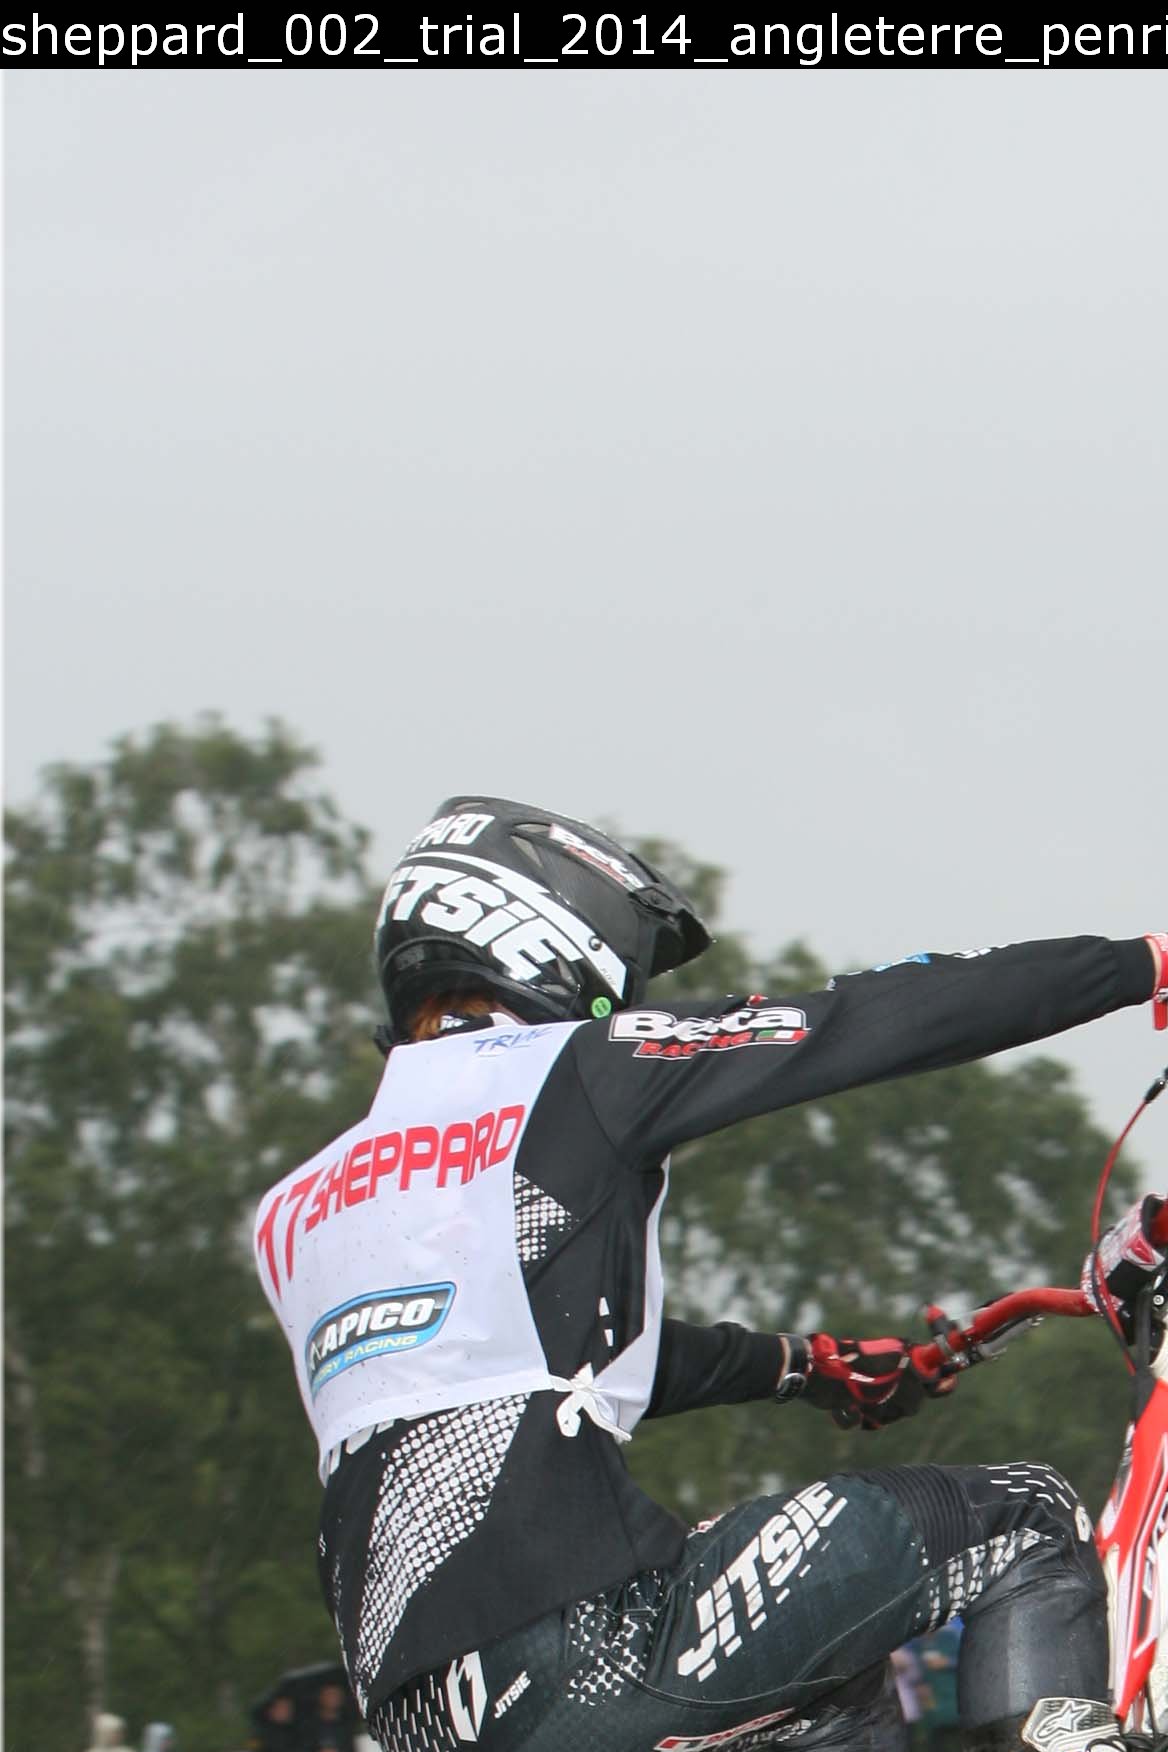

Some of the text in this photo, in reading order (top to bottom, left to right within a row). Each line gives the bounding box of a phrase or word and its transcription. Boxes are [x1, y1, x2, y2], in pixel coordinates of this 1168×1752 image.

[612, 1008, 807, 1042] Beta
[257, 1104, 526, 1303] 17 SHEPPARD
[321, 1298, 436, 1358] APICO
